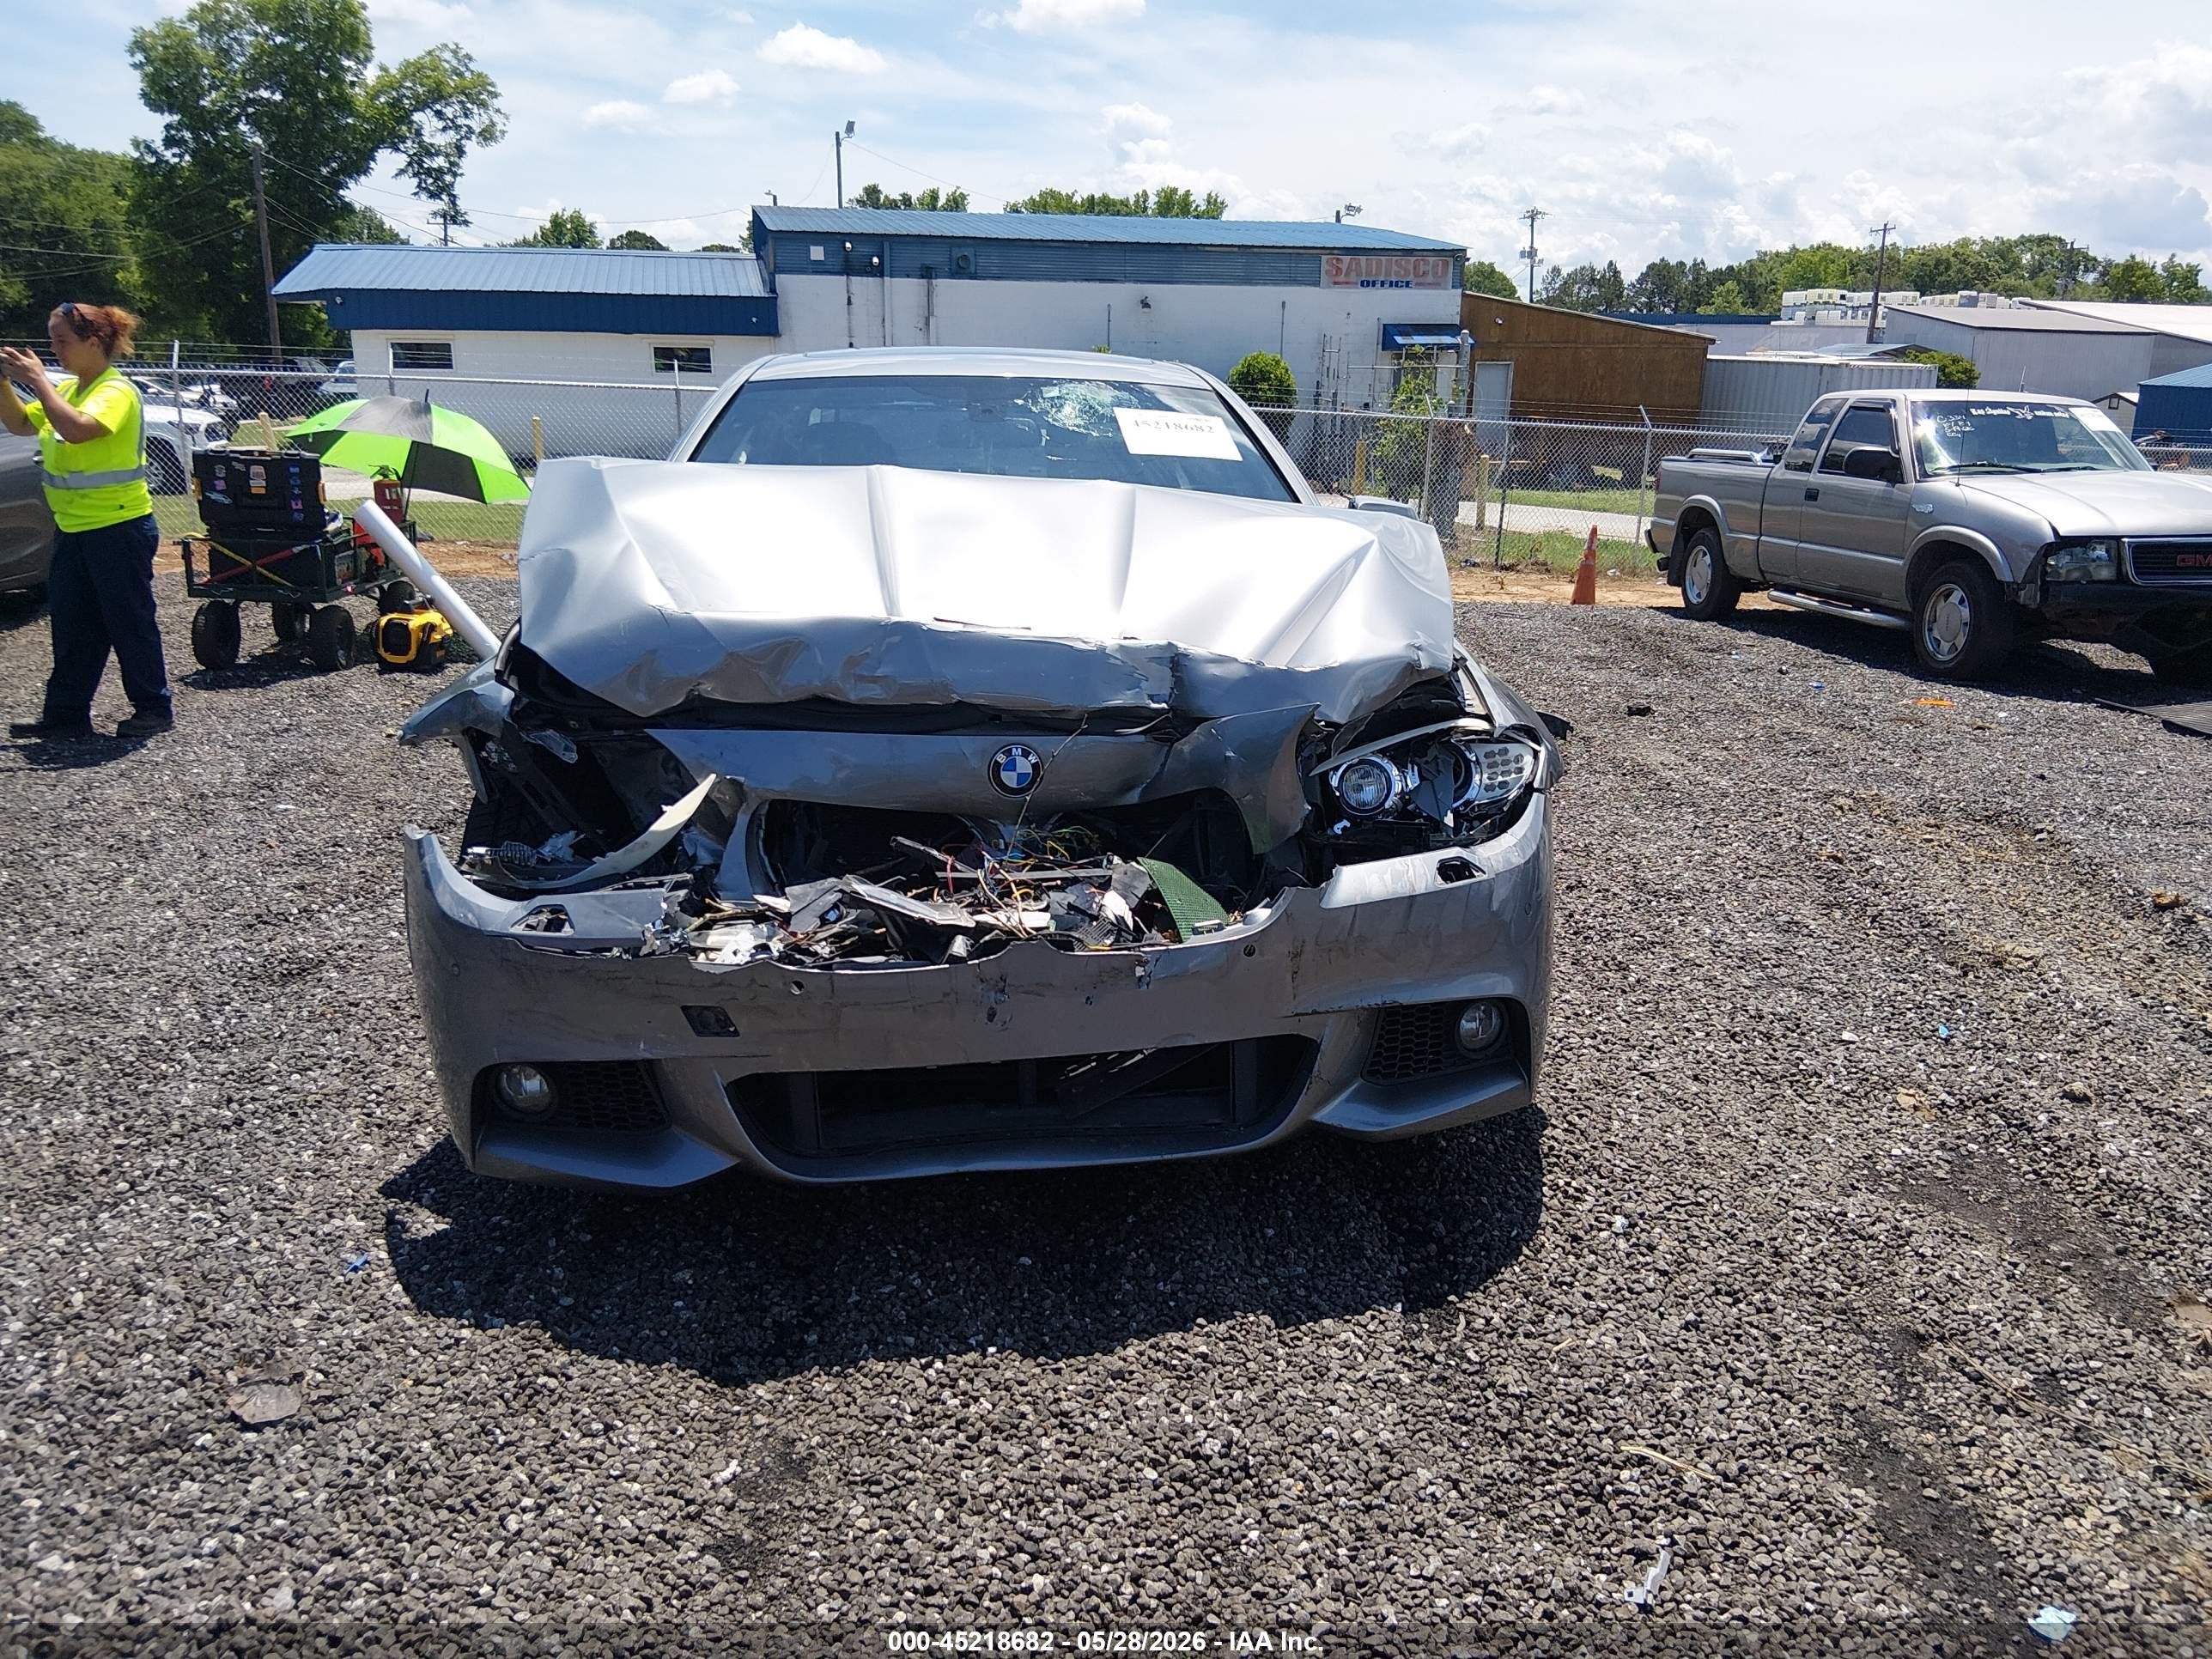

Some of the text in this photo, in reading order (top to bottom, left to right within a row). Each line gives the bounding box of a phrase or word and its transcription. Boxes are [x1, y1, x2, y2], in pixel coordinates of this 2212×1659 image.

[1325, 257, 1449, 279] SADISCO
[1359, 279, 1414, 289] OFFICE
[2177, 554, 2212, 567] GM
[996, 747, 1038, 764] BMW
